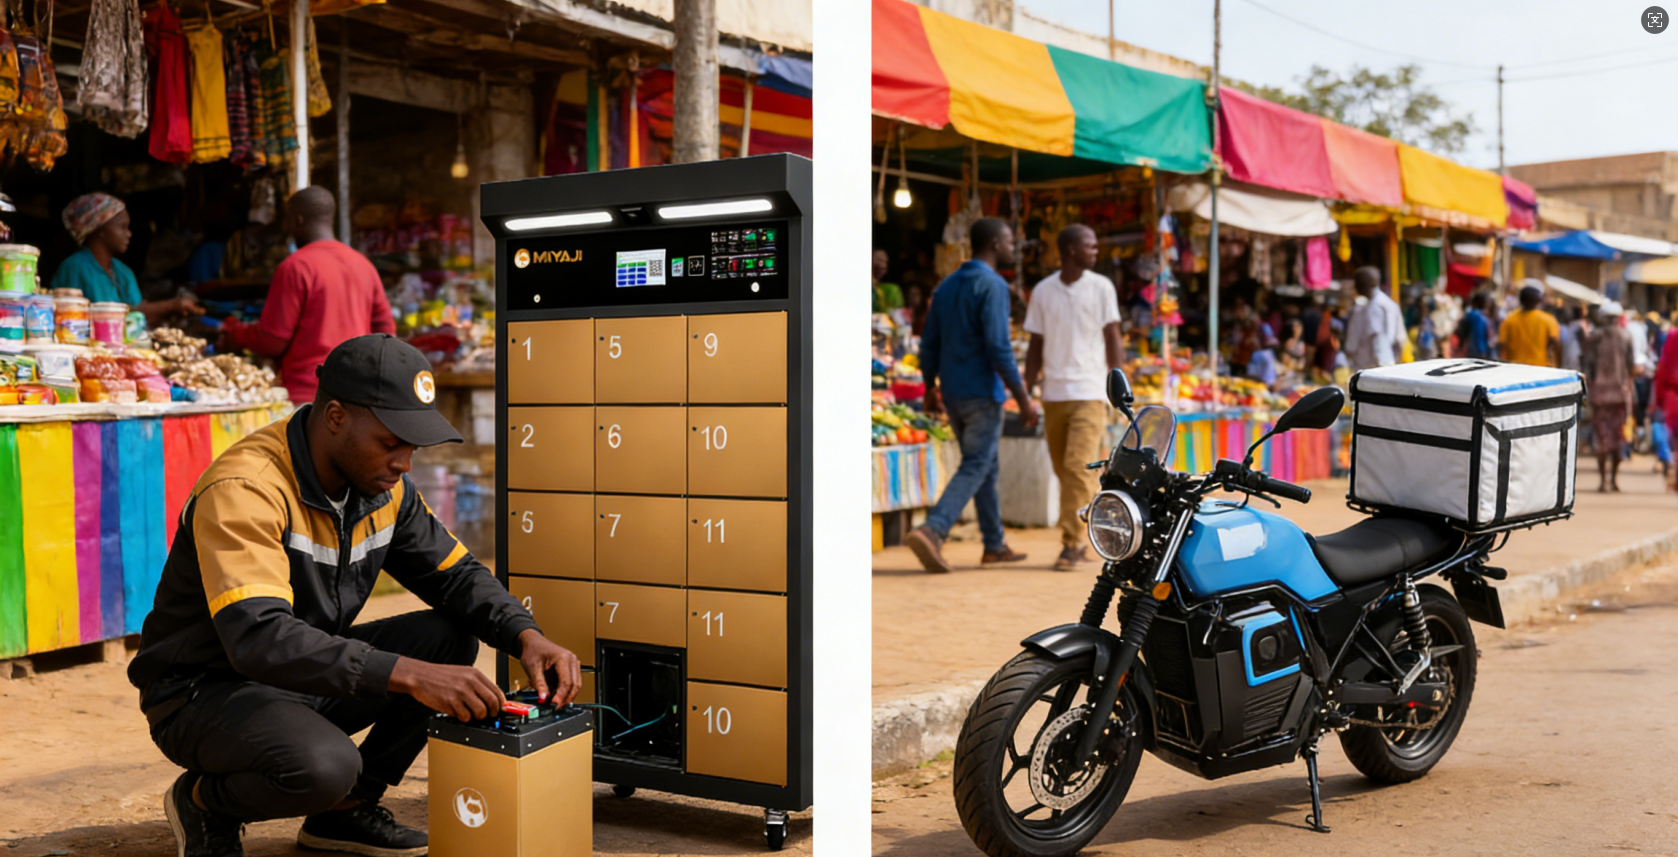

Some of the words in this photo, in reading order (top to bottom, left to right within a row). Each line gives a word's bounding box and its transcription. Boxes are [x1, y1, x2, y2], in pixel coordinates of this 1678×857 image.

[533, 250, 582, 263] MIYAJI
[522, 336, 532, 361] 1
[609, 335, 622, 359] 5
[703, 332, 718, 357] 9
[520, 423, 534, 448] 2
[608, 424, 622, 448] 6
[701, 425, 728, 450] 10
[521, 510, 534, 533] 5
[608, 513, 622, 537] 7
[703, 518, 725, 543] 11
[606, 602, 619, 623] 7
[702, 610, 724, 637] 11
[702, 705, 732, 734] 10
